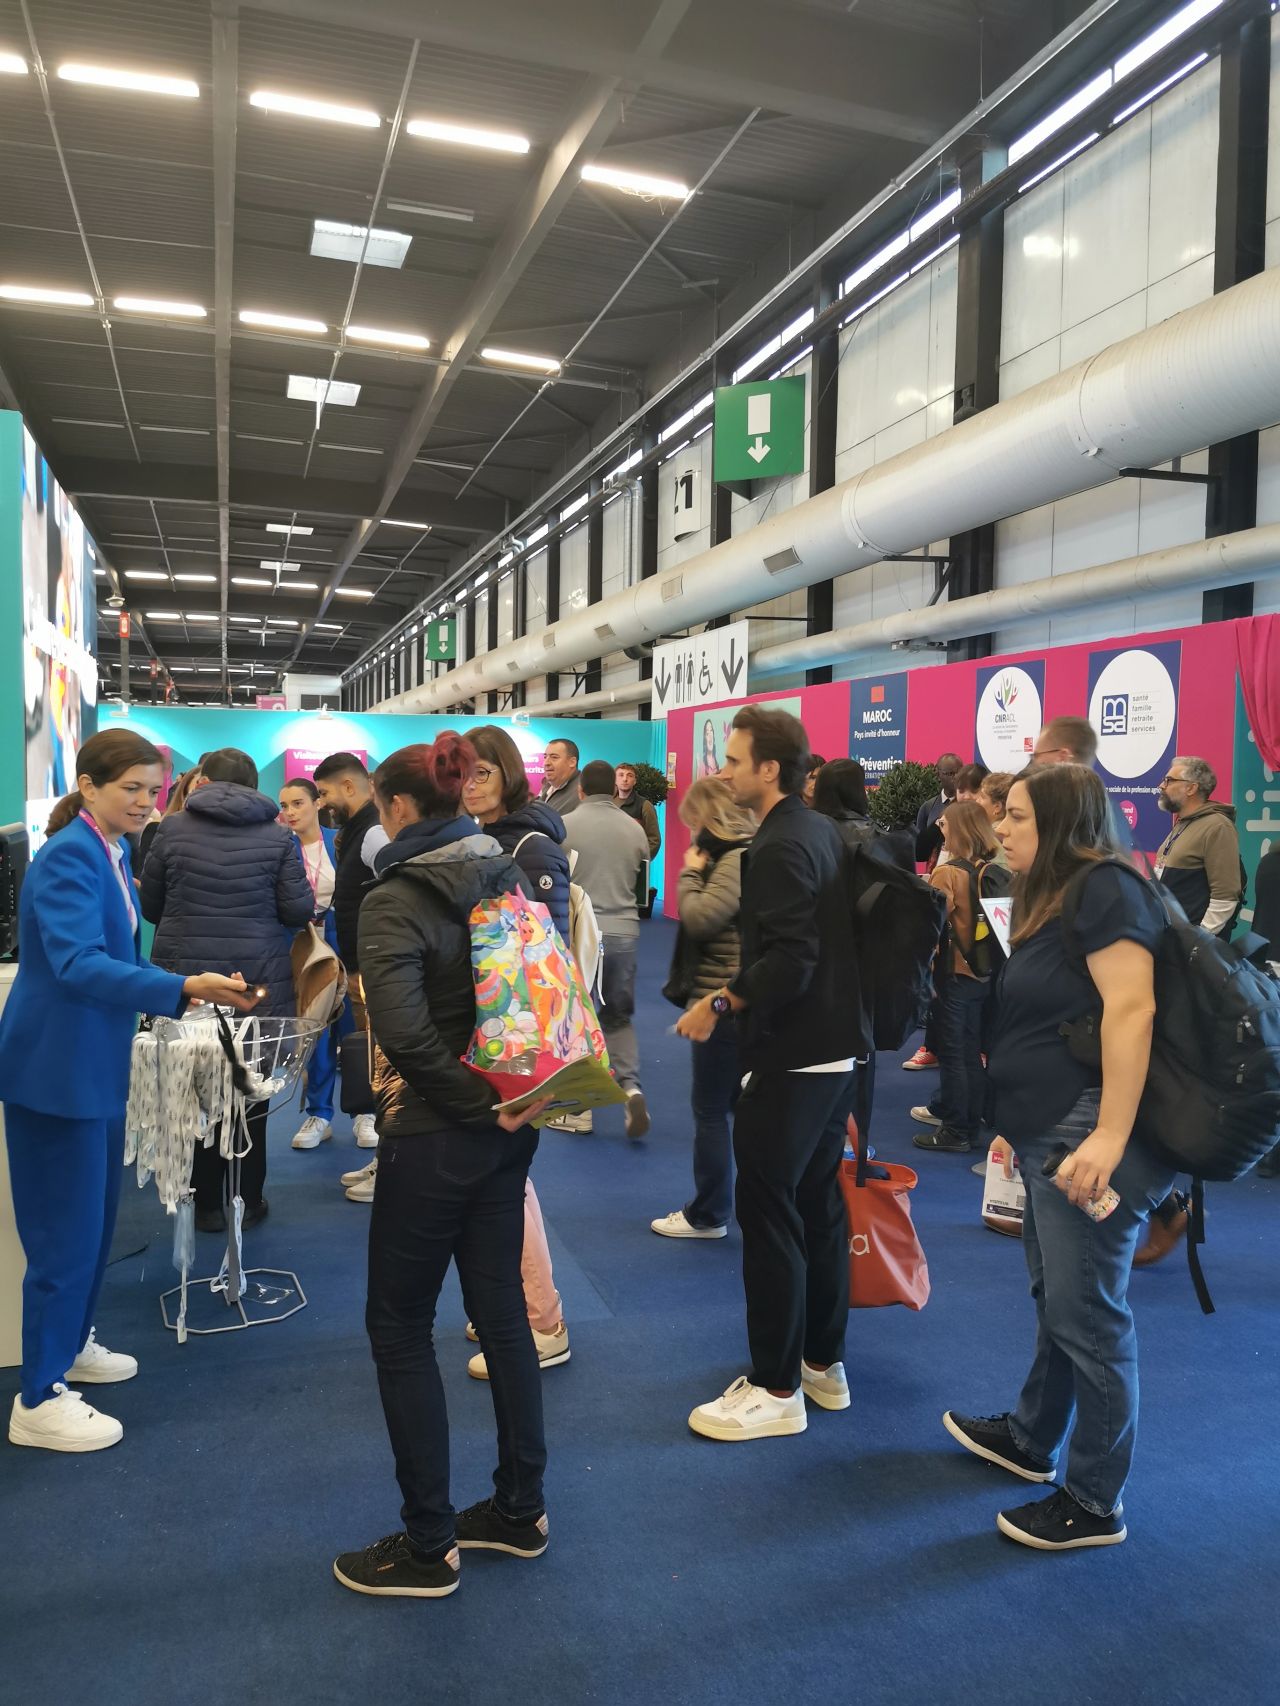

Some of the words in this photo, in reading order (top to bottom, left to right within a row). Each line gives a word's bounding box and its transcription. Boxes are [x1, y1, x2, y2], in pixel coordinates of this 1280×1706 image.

[863, 709, 892, 723] MAROC
[1131, 714, 1154, 722] retraite
[854, 731, 864, 740] Pays
[865, 729, 877, 738] invité
[1131, 786, 1151, 795] profession
